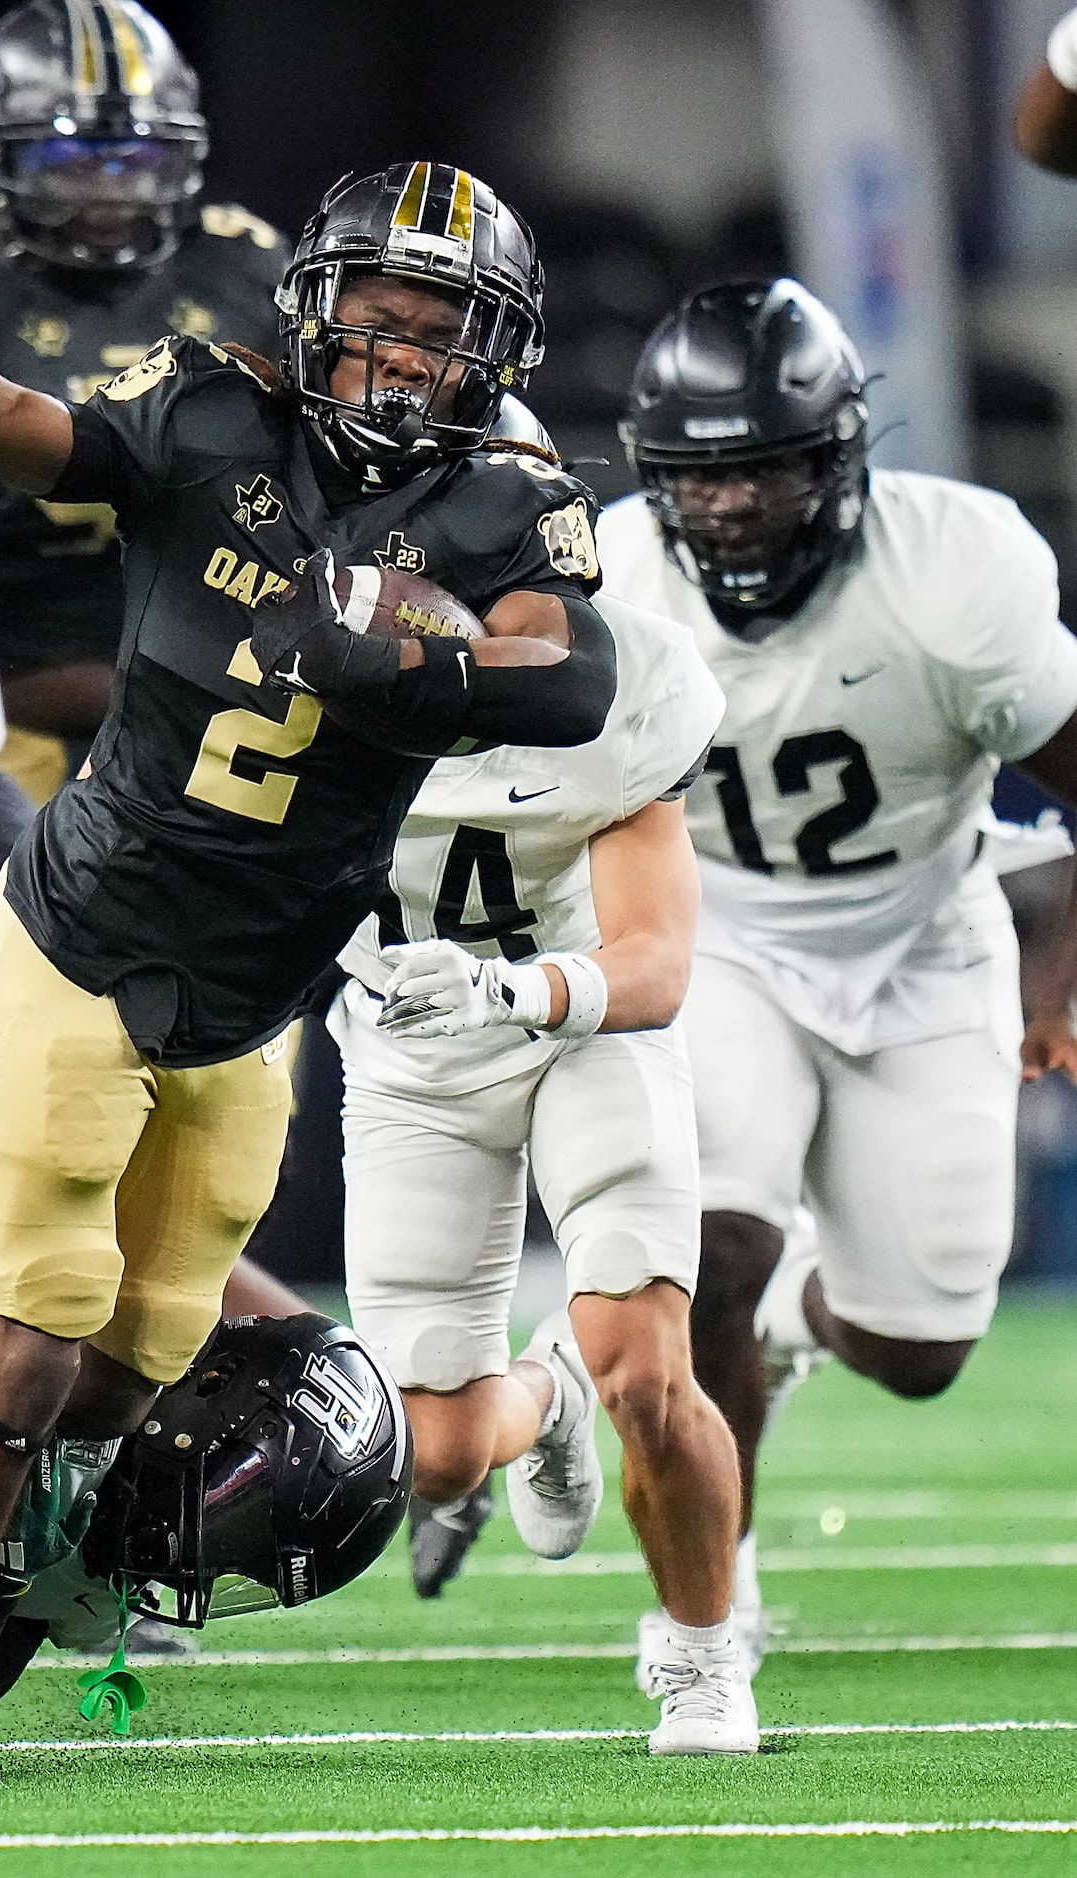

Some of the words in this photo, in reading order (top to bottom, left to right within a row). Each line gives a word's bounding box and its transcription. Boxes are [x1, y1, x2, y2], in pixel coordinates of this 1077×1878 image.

[301, 328, 319, 340] CLIFF
[303, 319, 317, 330] OAK
[251, 494, 272, 517] 21
[395, 548, 419, 569] 22
[183, 637, 323, 825] 2
[703, 728, 899, 878] 12
[40, 1447, 53, 1494] ADIZERO
[290, 1555, 309, 1604] Riddell
